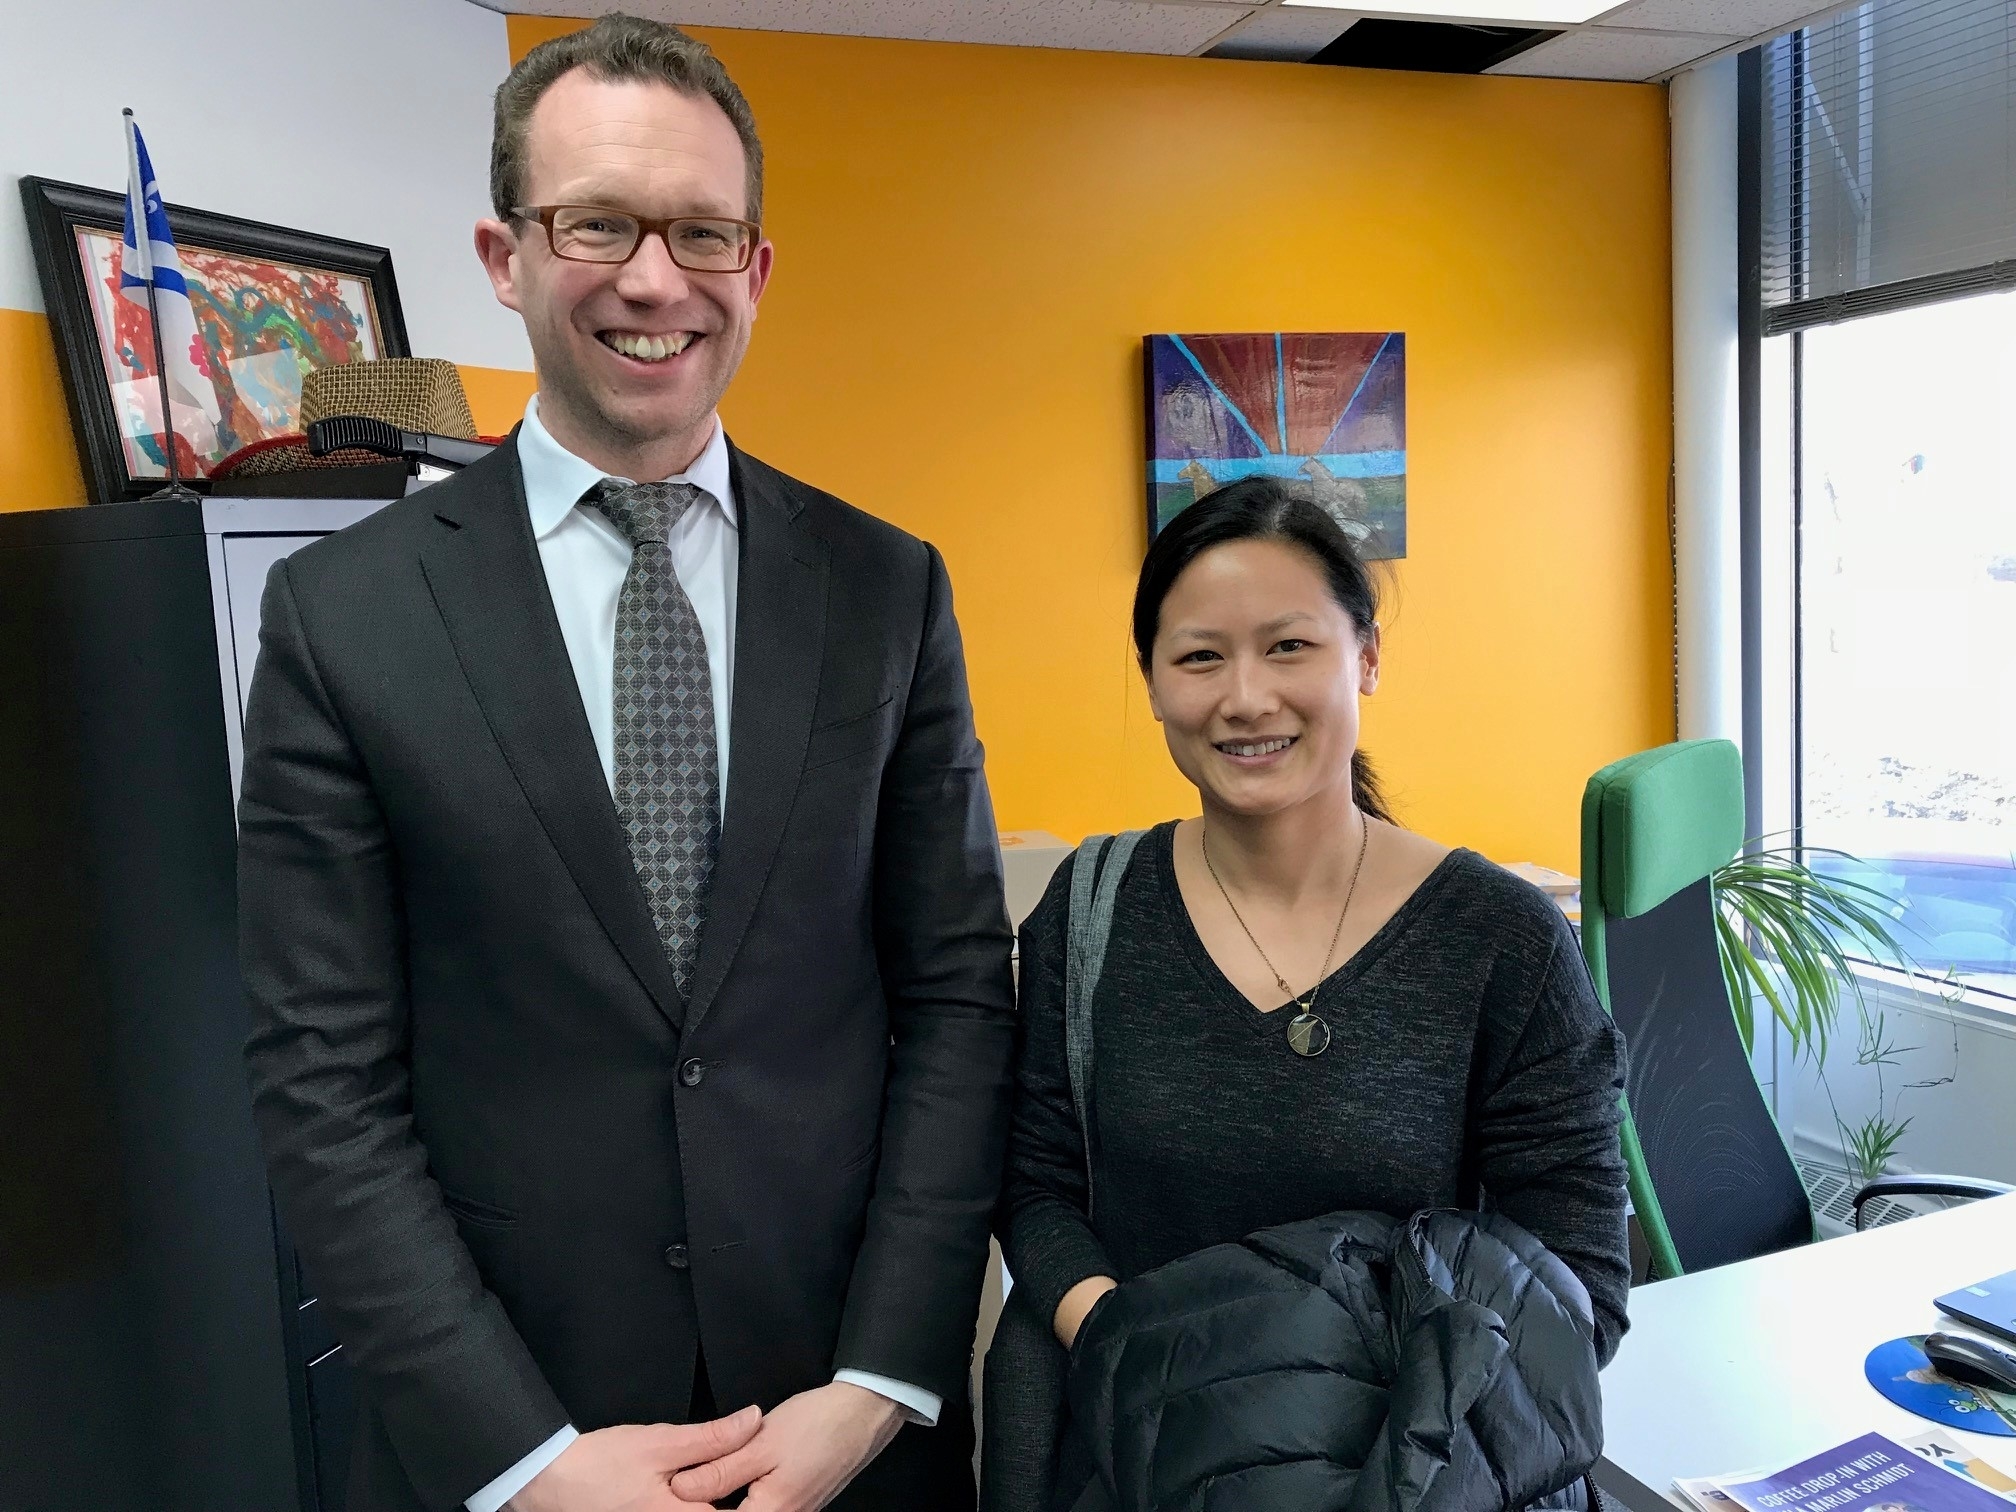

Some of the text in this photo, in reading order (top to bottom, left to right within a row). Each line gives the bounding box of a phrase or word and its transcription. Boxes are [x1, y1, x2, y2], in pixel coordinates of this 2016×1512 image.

[1757, 1485, 1810, 1508] COFFEE
[1801, 1465, 1860, 1494] DROP-IN
[1850, 1451, 1892, 1472] WITH
[1805, 1462, 1915, 1512] MARLIN SCHMIDT
